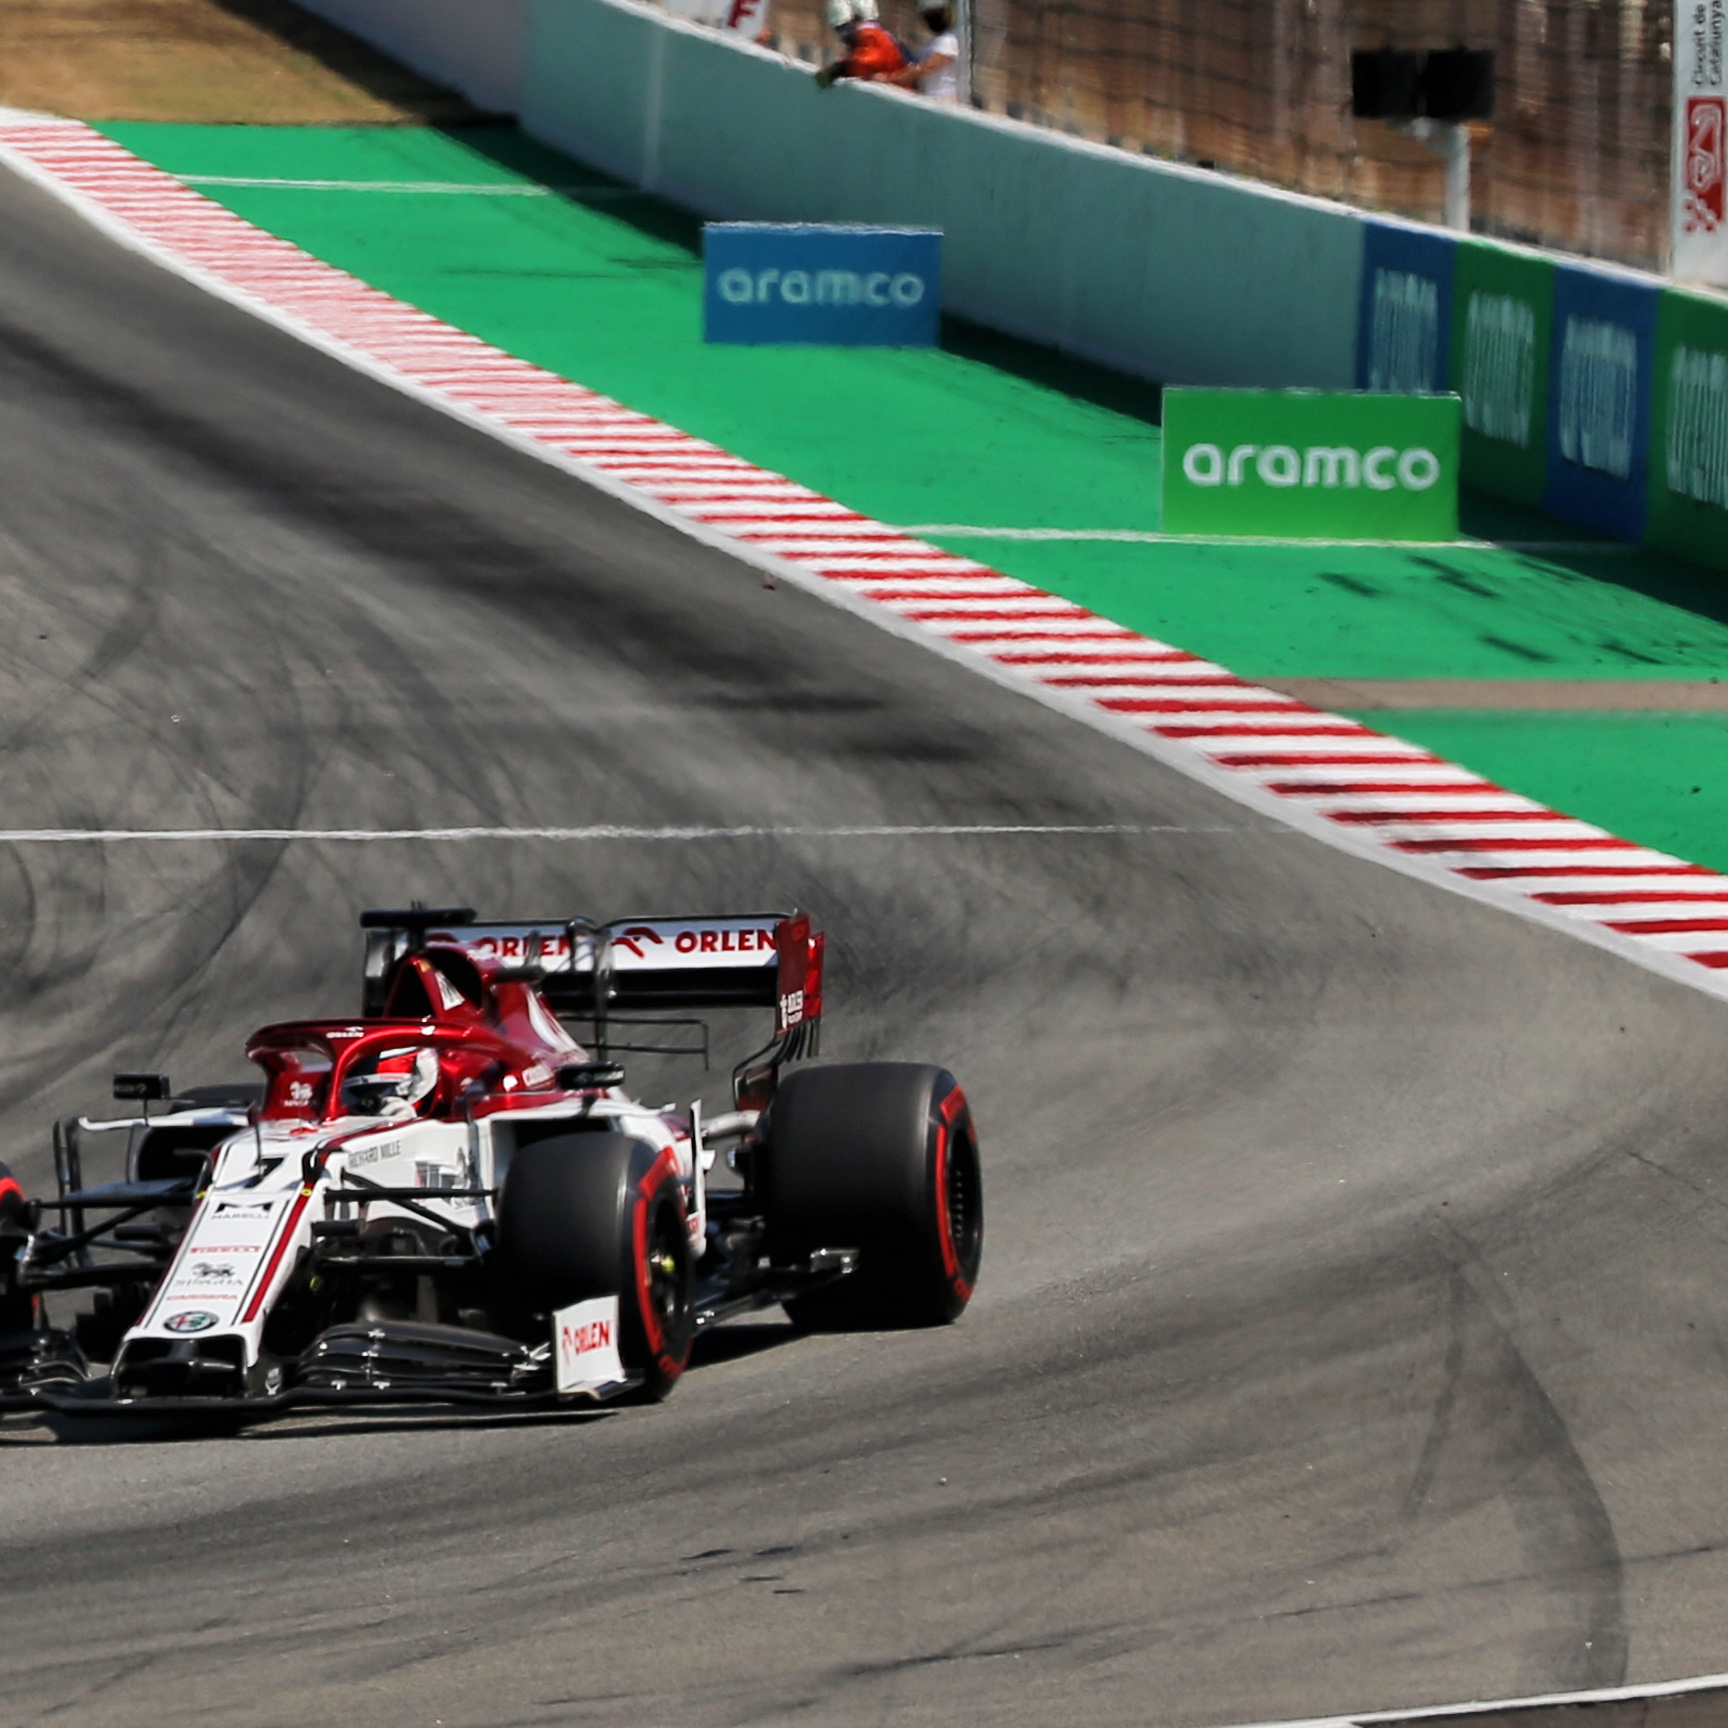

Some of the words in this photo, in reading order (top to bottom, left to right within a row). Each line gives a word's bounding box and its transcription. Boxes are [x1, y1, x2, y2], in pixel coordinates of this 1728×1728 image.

[718, 268, 926, 311] aramco
[1182, 441, 1441, 492] aramco
[674, 928, 777, 954] ORLEN
[379, 1139, 402, 1162] MILLE
[574, 1320, 612, 1356] ORLEN
